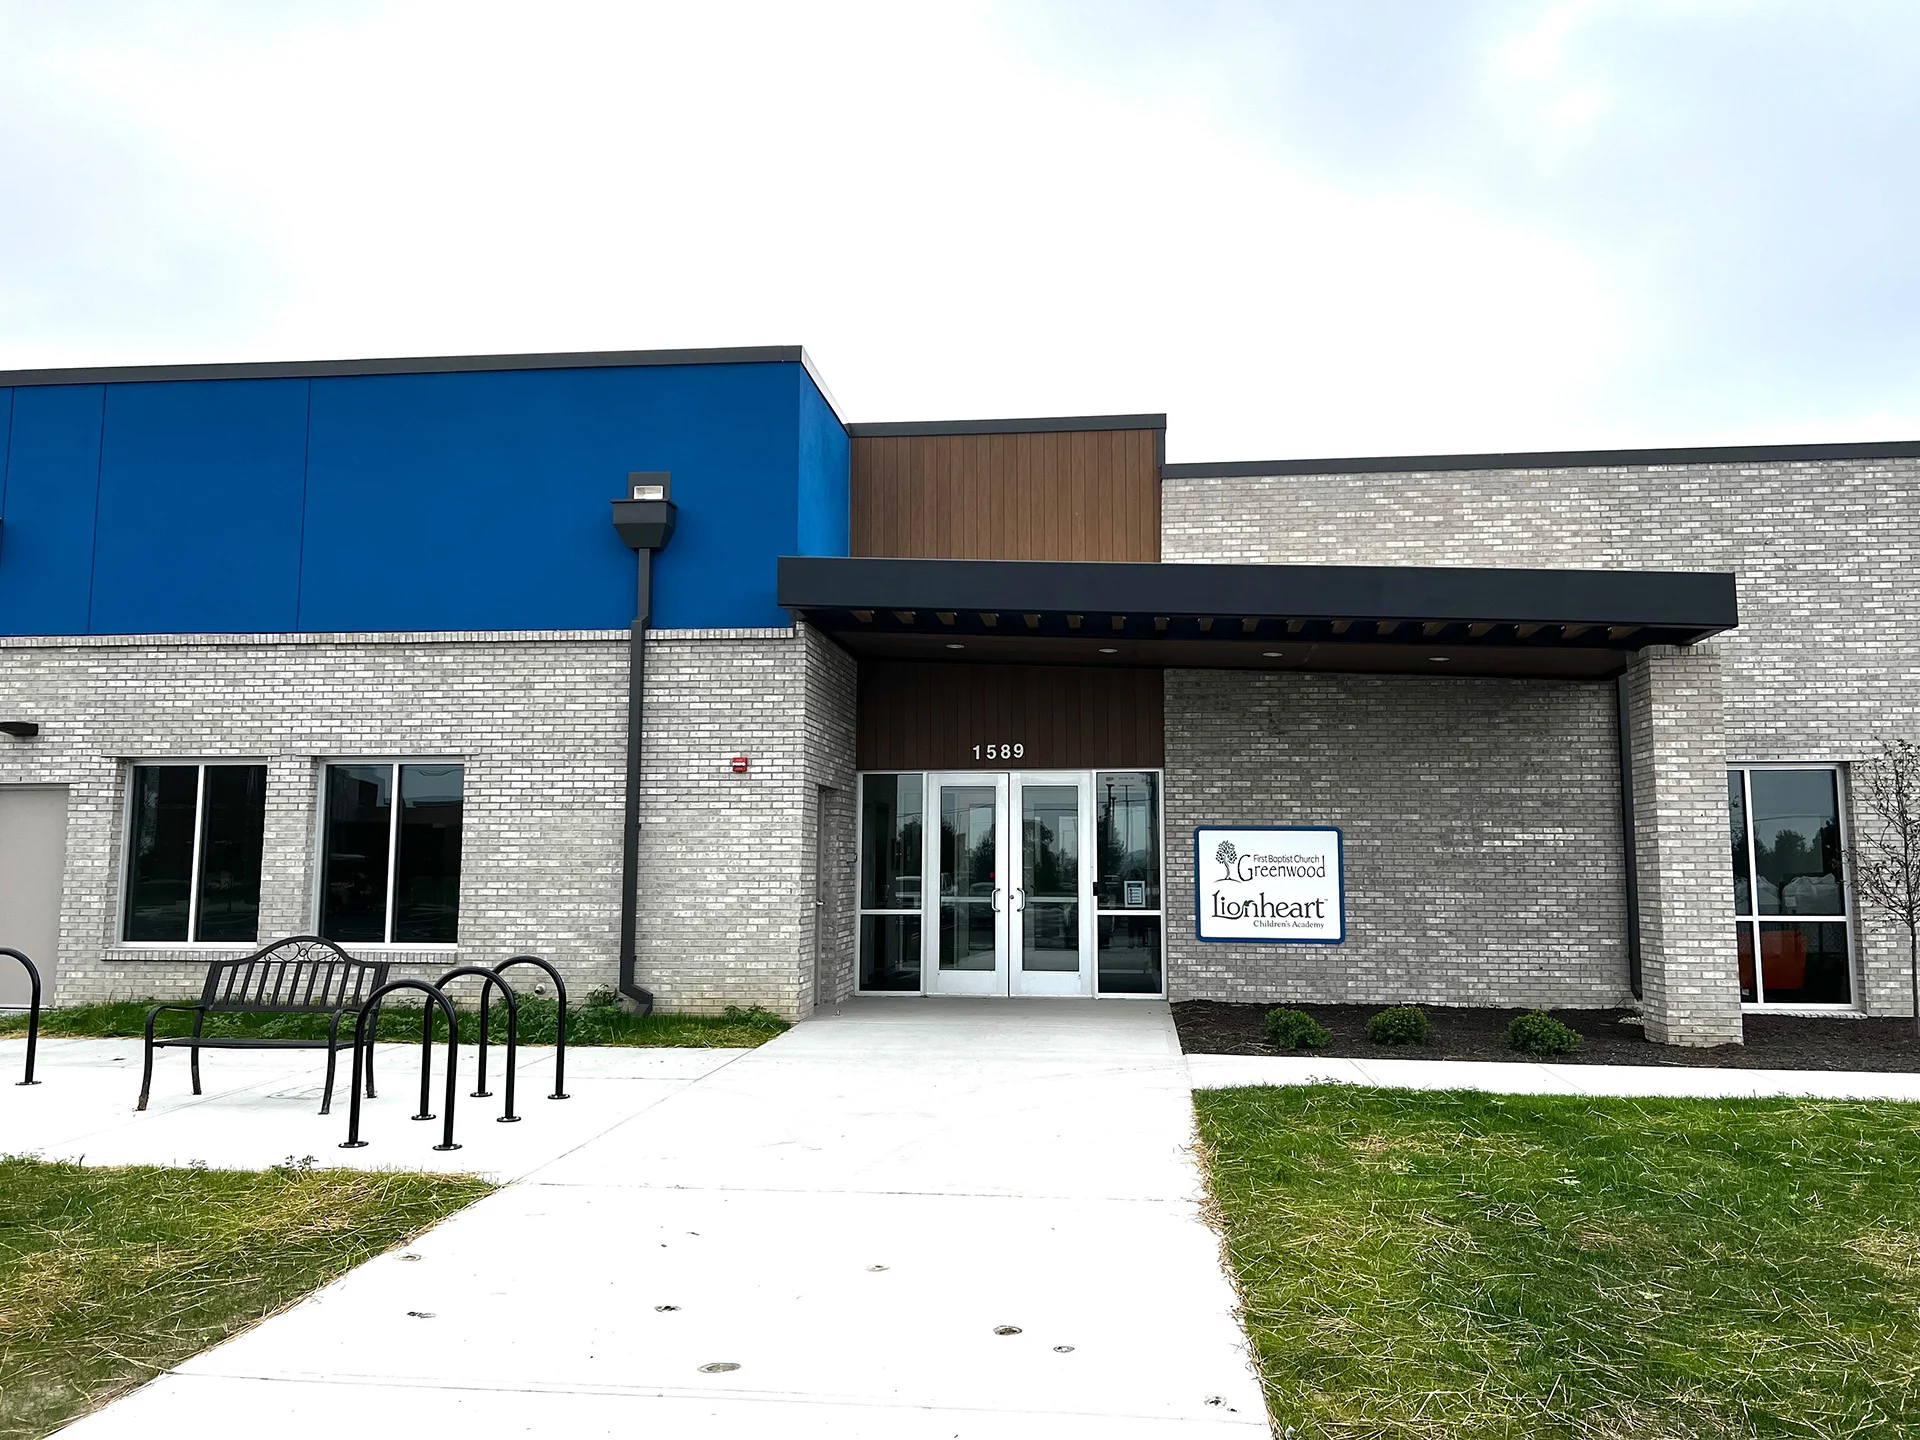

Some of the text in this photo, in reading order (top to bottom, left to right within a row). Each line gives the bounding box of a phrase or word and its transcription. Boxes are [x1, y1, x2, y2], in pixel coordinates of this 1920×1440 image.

[973, 743, 1024, 760] 1589
[1237, 854, 1326, 881] Greenwood
[1253, 854, 1320, 864] First Baptist Church
[1212, 890, 1325, 920] Lionheart
[1253, 920, 1325, 929] Children's Academy
